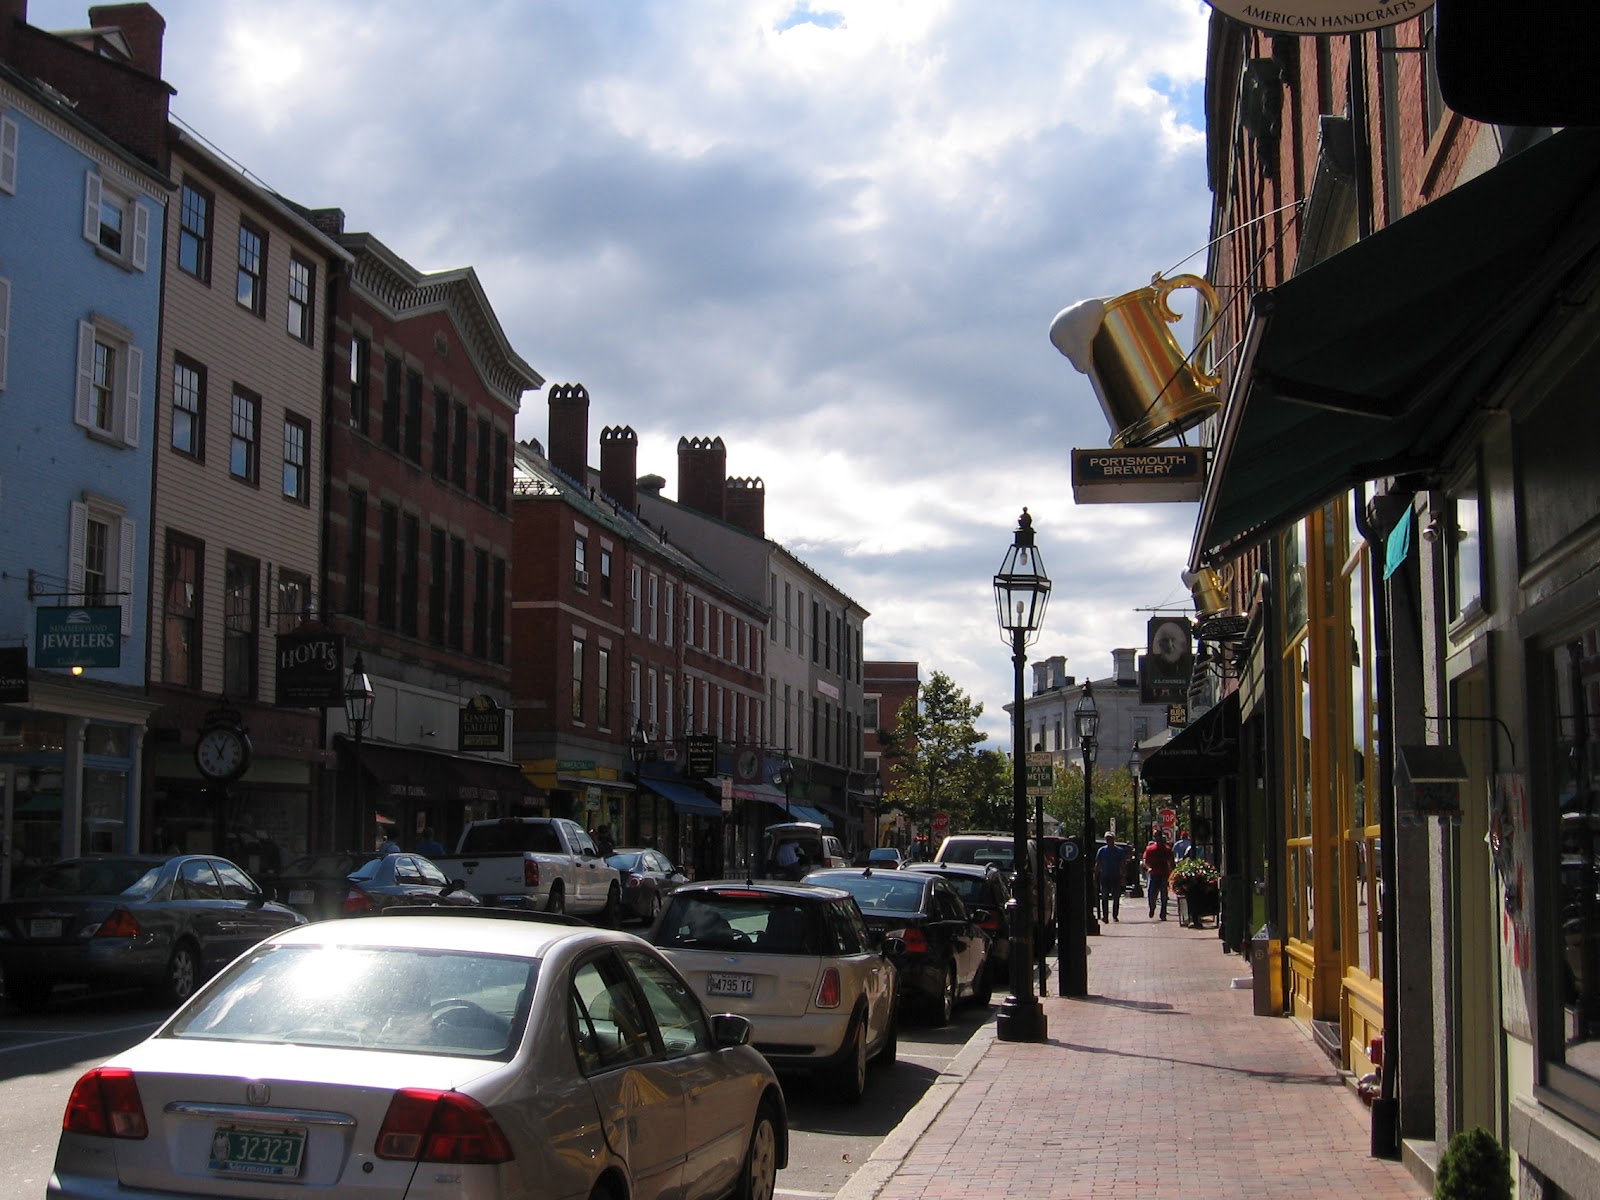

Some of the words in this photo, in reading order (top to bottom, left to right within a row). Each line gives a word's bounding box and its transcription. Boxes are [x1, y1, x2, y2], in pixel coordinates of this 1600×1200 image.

[1242, 5, 1317, 27] AMERICAN
[1321, 0, 1416, 27] HANDCRAFTS
[1090, 455, 1187, 467] PORTSMOUTH
[1103, 464, 1173, 476] BREWERY
[49, 624, 108, 632] SUMMERWIND
[42, 633, 115, 651] JEWELERS
[463, 722, 498, 732] GALLERY
[1026, 754, 1032, 762] 2
[1031, 766, 1047, 774] PAY
[1027, 773, 1051, 781] METER
[932, 818, 948, 827] STOP
[1065, 844, 1074, 858] P
[716, 978, 738, 991] 4795
[741, 980, 751, 993] TC
[236, 1136, 293, 1164] 32323
[229, 1163, 275, 1174] Vermont
